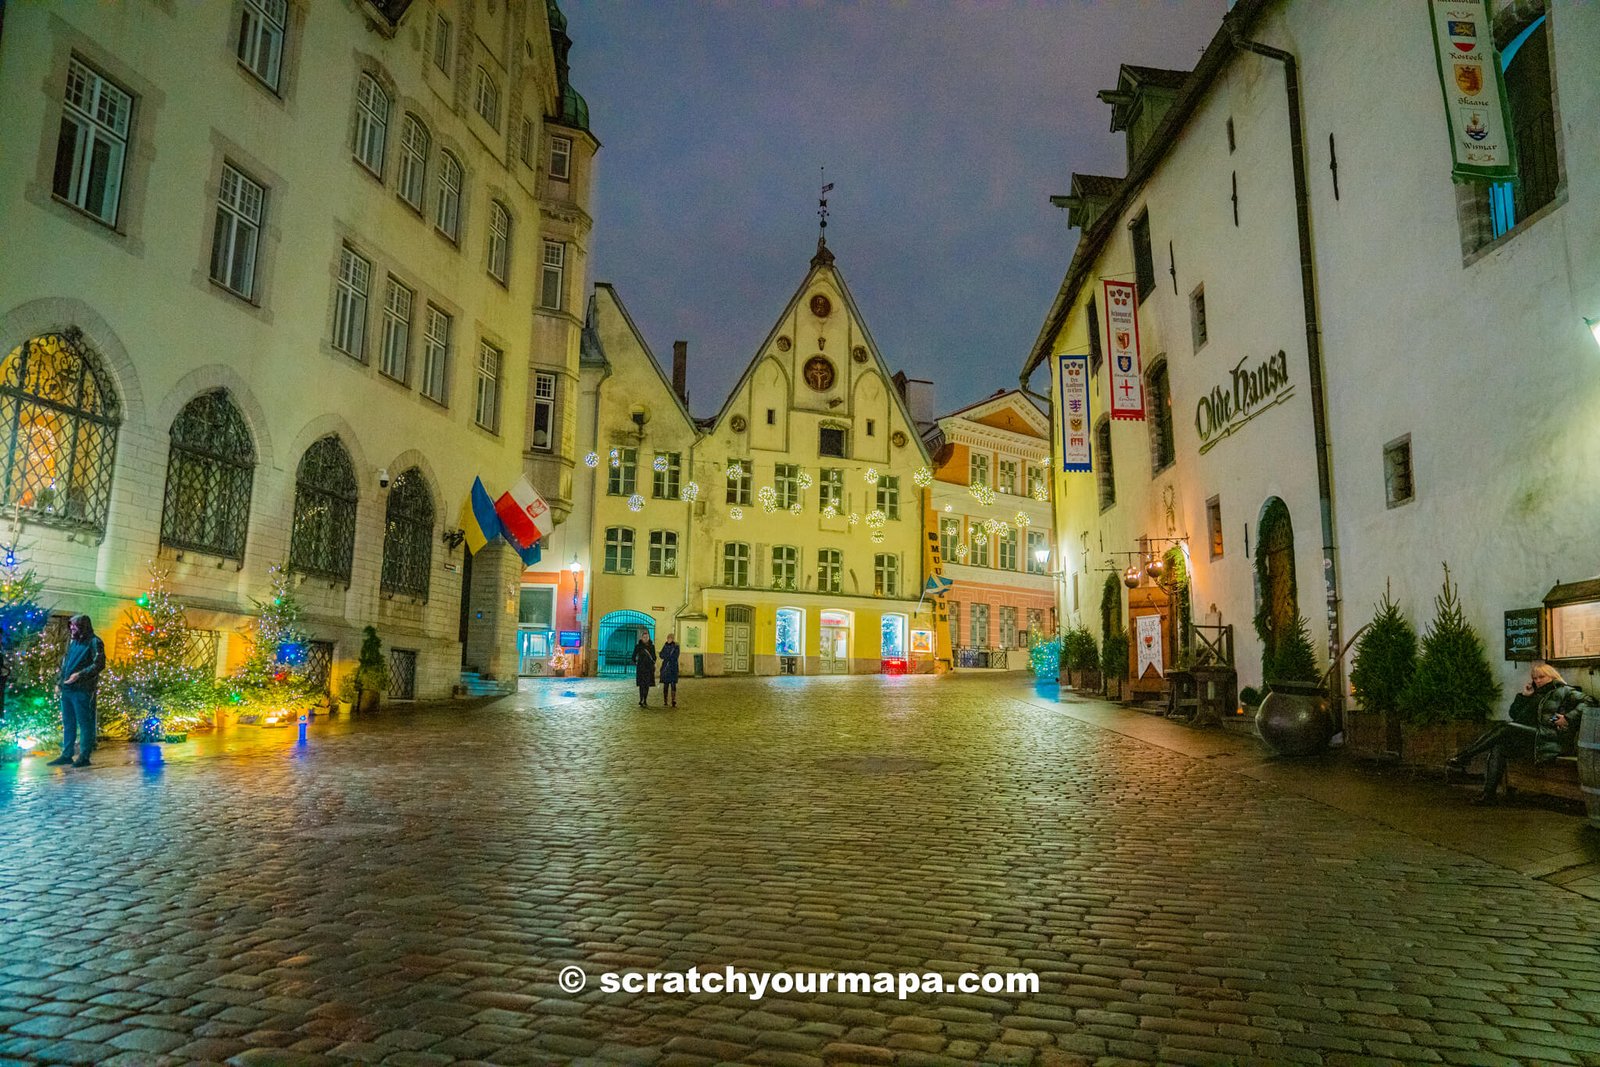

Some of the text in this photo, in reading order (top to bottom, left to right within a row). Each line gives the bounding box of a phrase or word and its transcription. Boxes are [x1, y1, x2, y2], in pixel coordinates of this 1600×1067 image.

[1462, 141, 1498, 151] Wismar
[1194, 349, 1289, 441] Olde Hansa
[931, 546, 947, 622] MUUEUM
